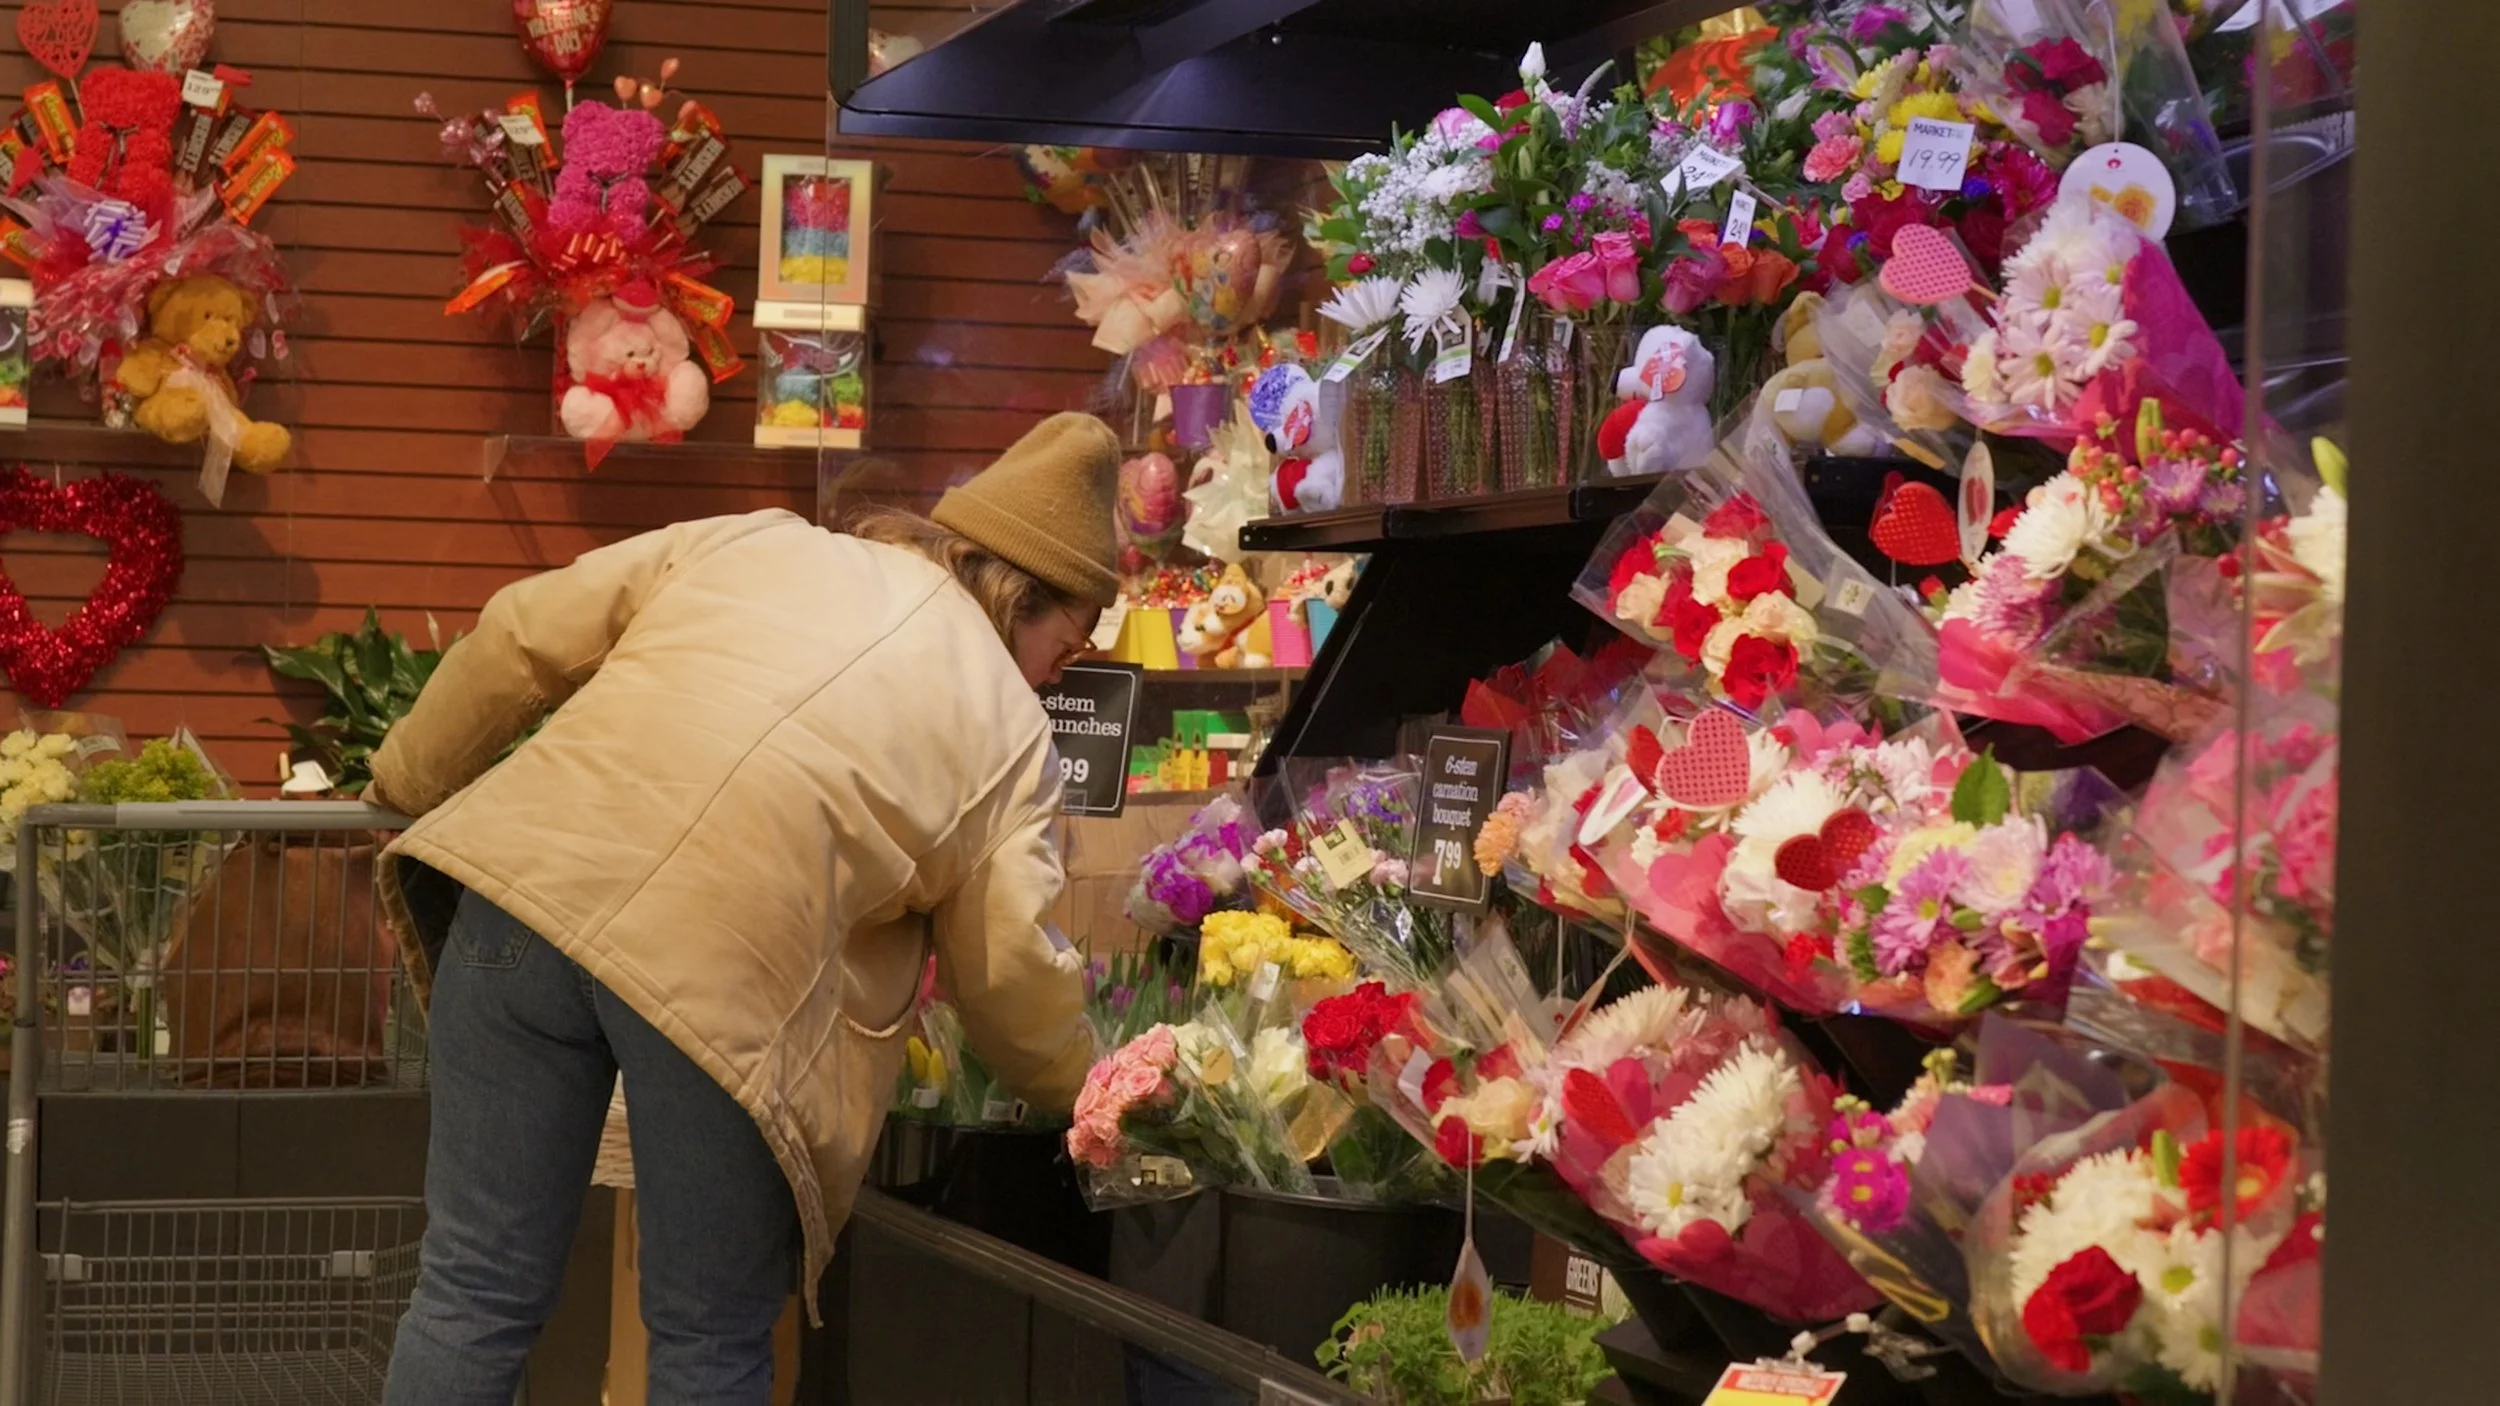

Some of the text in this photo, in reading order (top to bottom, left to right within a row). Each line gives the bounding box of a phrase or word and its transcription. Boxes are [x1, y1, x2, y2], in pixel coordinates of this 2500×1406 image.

[1912, 123, 1952, 138] MARKET
[1041, 693, 1096, 712] -stem
[1050, 717, 1122, 736] unches
[1060, 757, 1090, 784] 99
[1444, 755, 1478, 777] 6-stem
[1432, 780, 1479, 802] carnation
[1432, 803, 1472, 831] bouquet
[1565, 1255, 1601, 1297] GREENS
